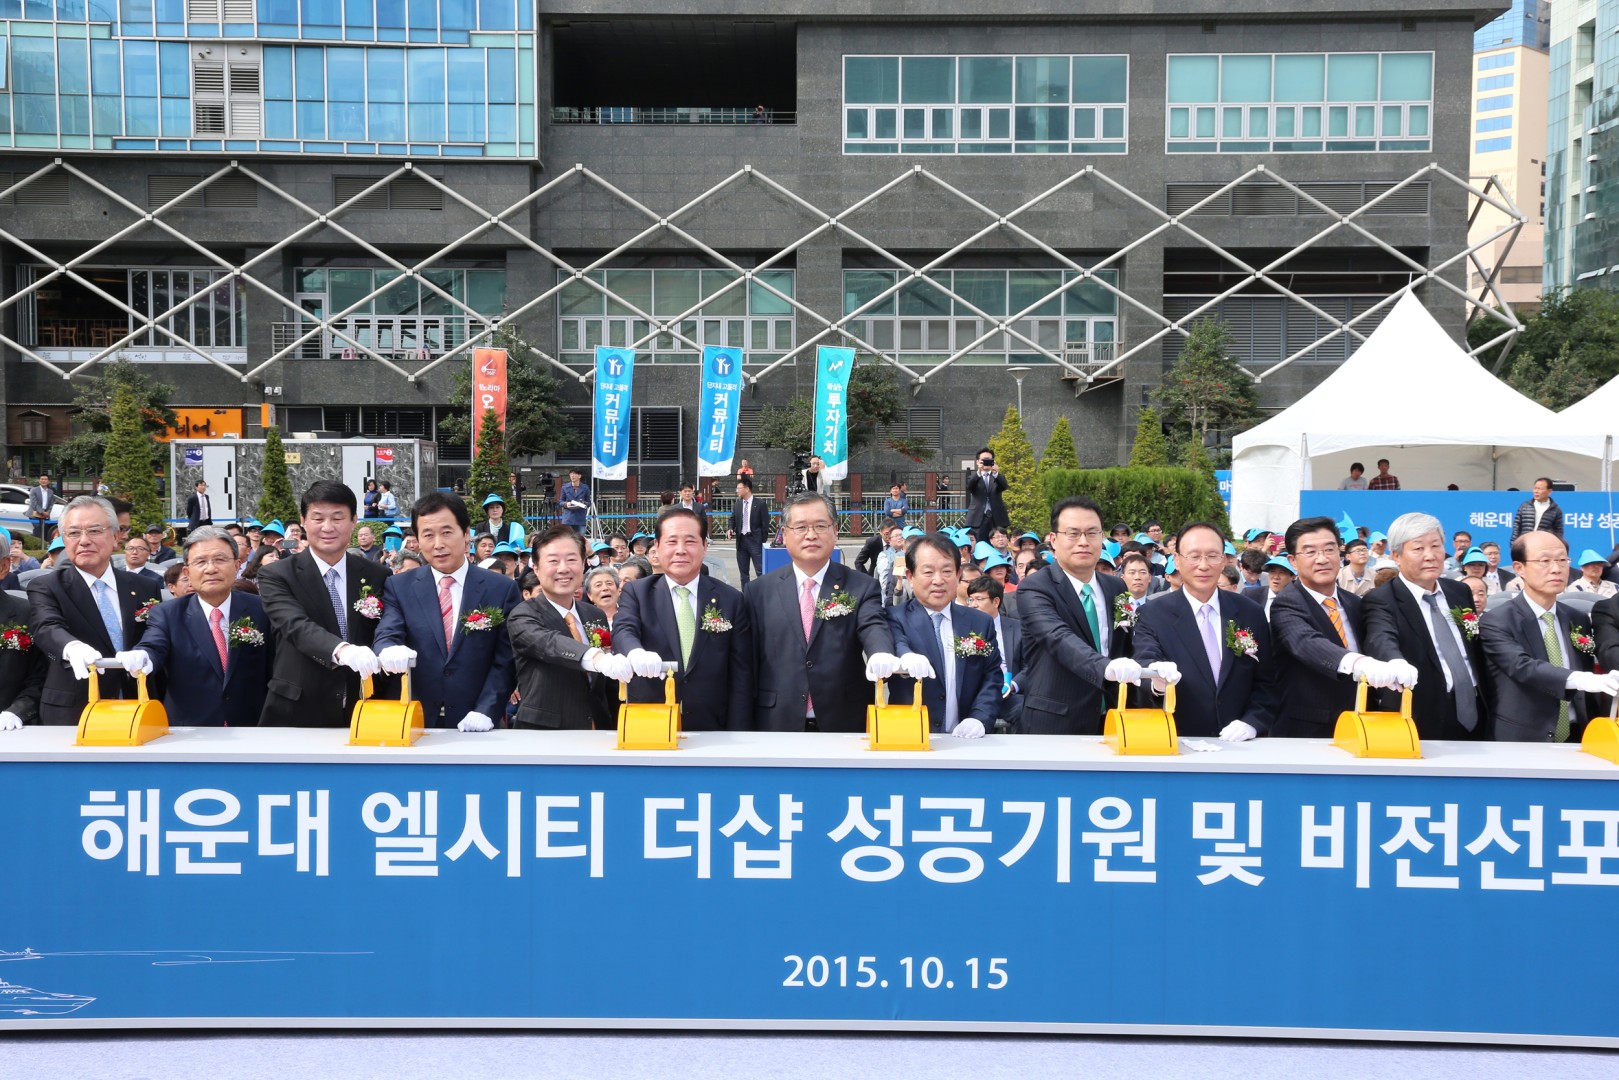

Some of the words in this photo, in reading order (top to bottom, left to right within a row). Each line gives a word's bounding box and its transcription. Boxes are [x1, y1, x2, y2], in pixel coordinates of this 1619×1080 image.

[602, 393, 620, 457] 커뮤니티
[709, 392, 728, 454] 커뮤니티
[823, 392, 841, 457] 투자가치
[1469, 511, 1513, 529] 해운대
[1564, 511, 1594, 529] 더샵
[80, 788, 330, 877] 해운대
[361, 790, 605, 878] 엘시티
[643, 792, 803, 879] 더샵
[826, 794, 1157, 884] 성공기원
[1192, 799, 1265, 887] 및
[1300, 801, 1619, 892] 비전선포
